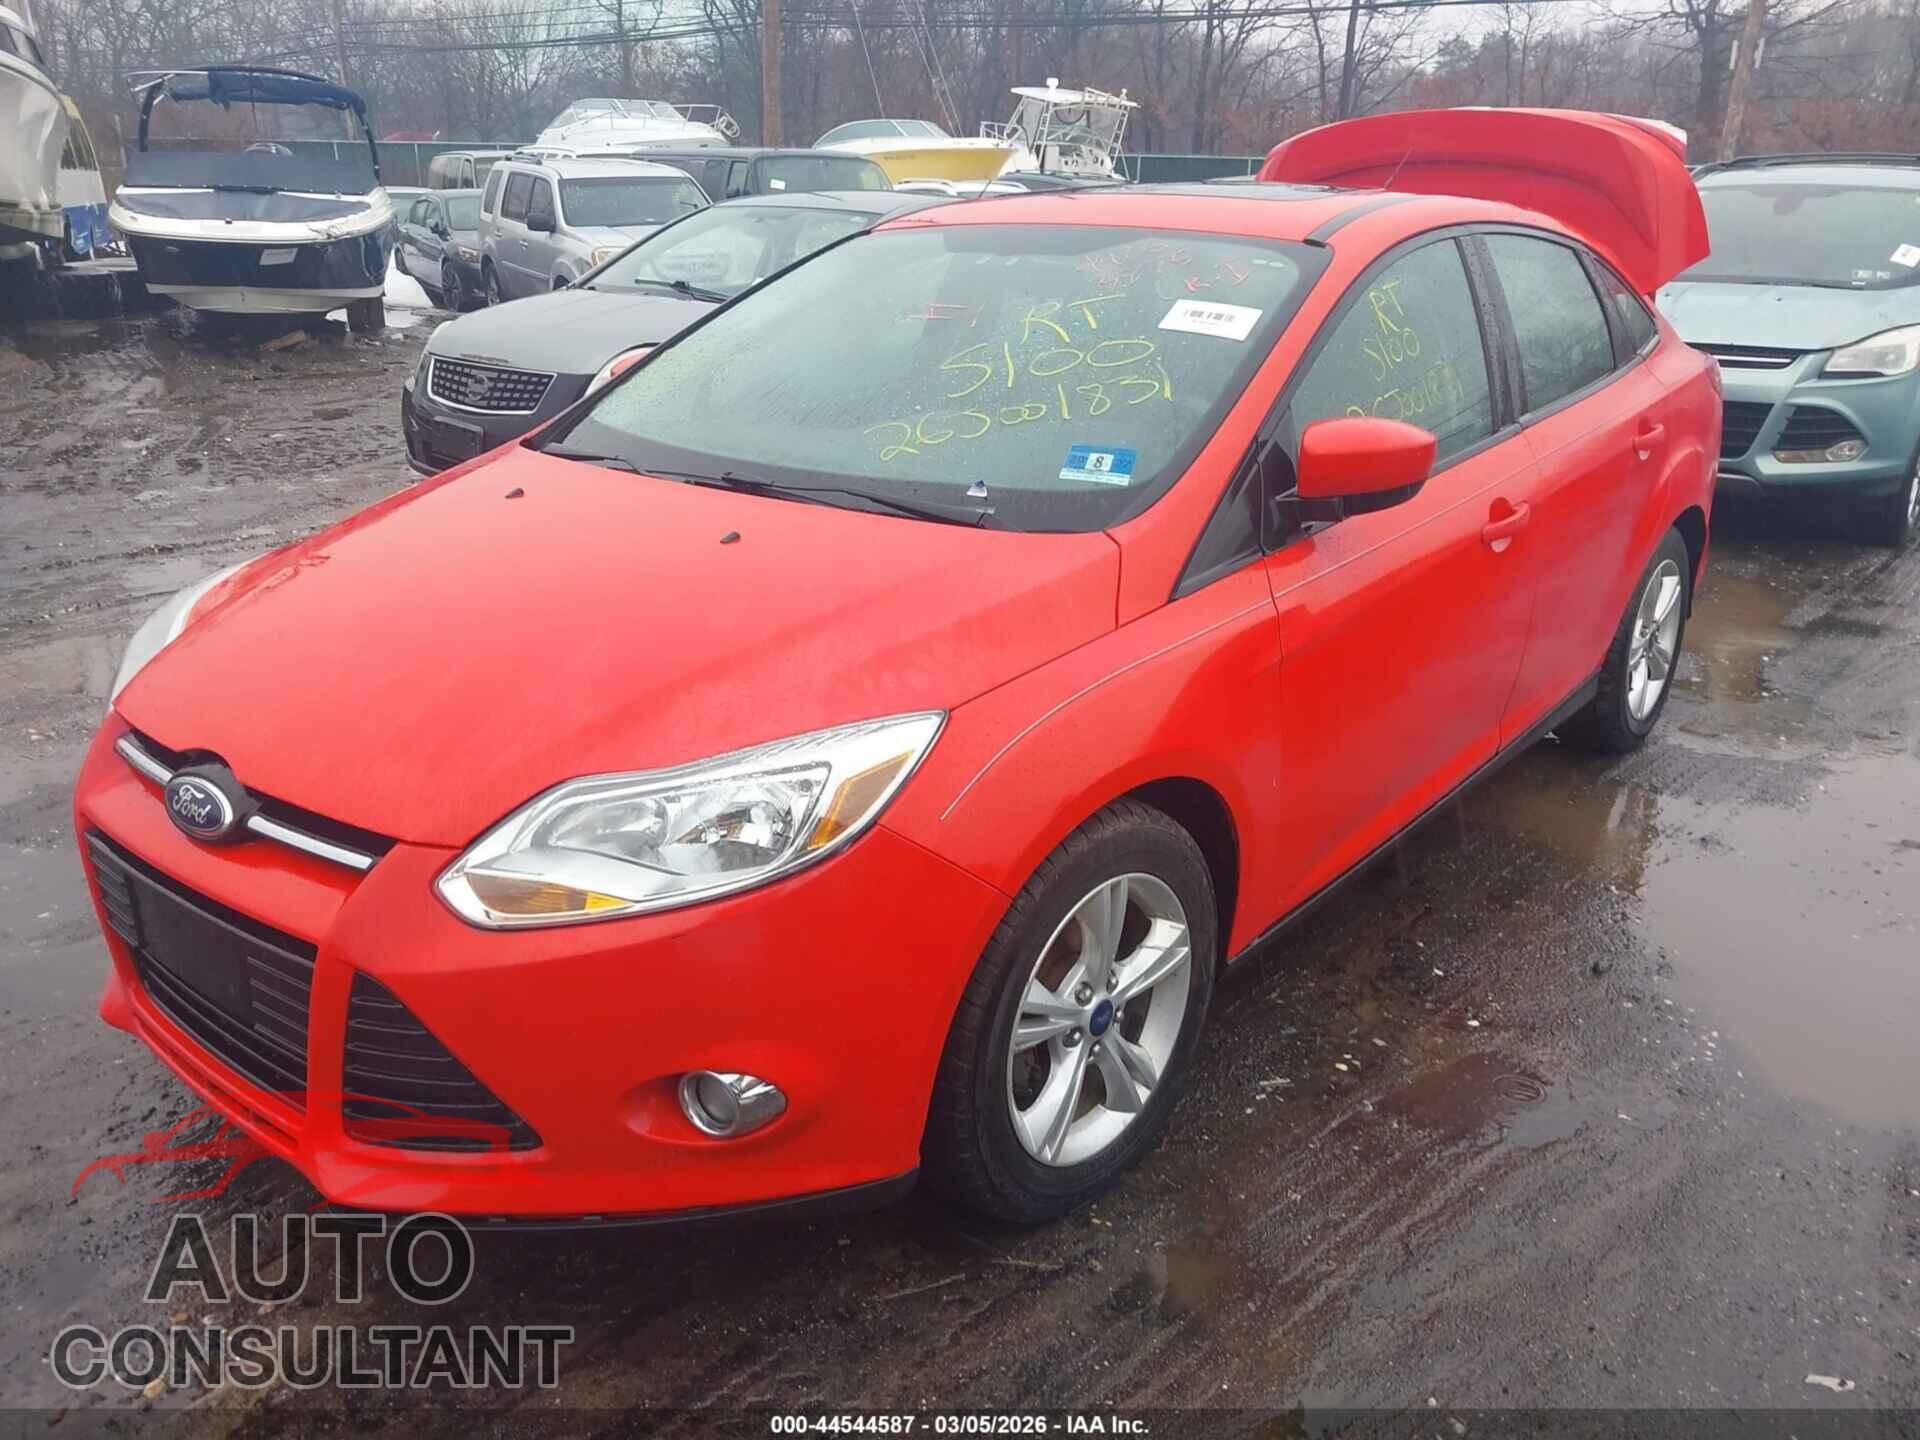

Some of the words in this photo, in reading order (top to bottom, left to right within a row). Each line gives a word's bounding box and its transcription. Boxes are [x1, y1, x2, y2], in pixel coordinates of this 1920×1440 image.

[1021, 294, 1127, 344] RT
[1093, 455, 1105, 469] 8
[172, 784, 212, 825] Ford
